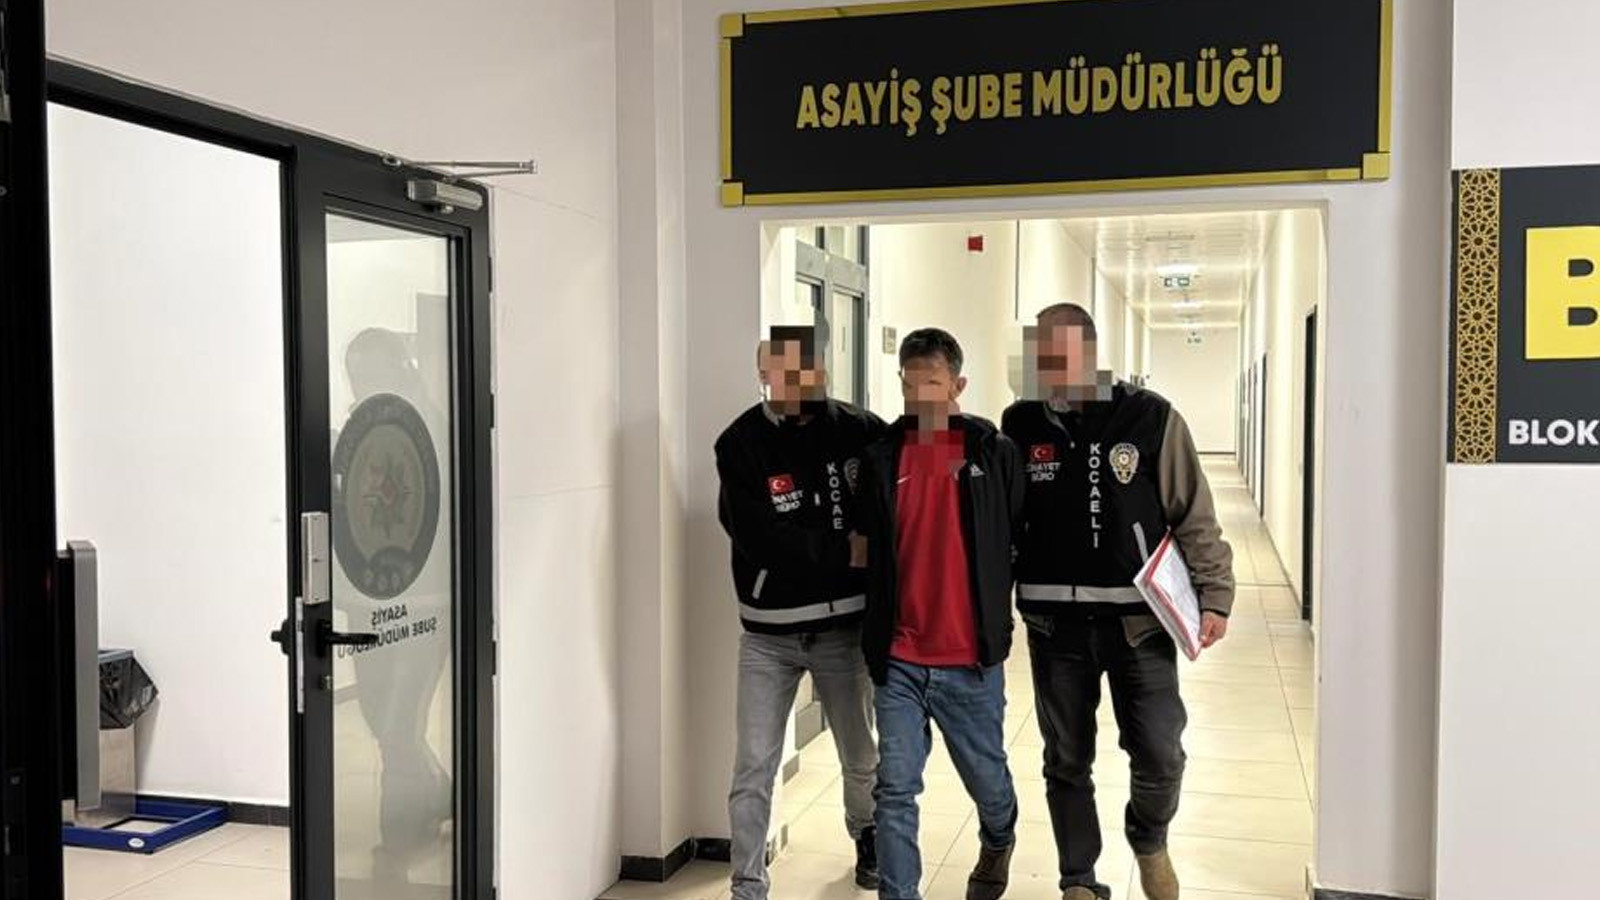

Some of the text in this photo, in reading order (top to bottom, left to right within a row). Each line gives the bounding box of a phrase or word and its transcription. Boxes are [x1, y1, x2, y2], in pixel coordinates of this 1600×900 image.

[797, 44, 1283, 137] ASAYİŞ ŞUBE MÜDÜRLÜĞÜ
[1525, 225, 1600, 360] B
[1508, 418, 1600, 446] BLOK
